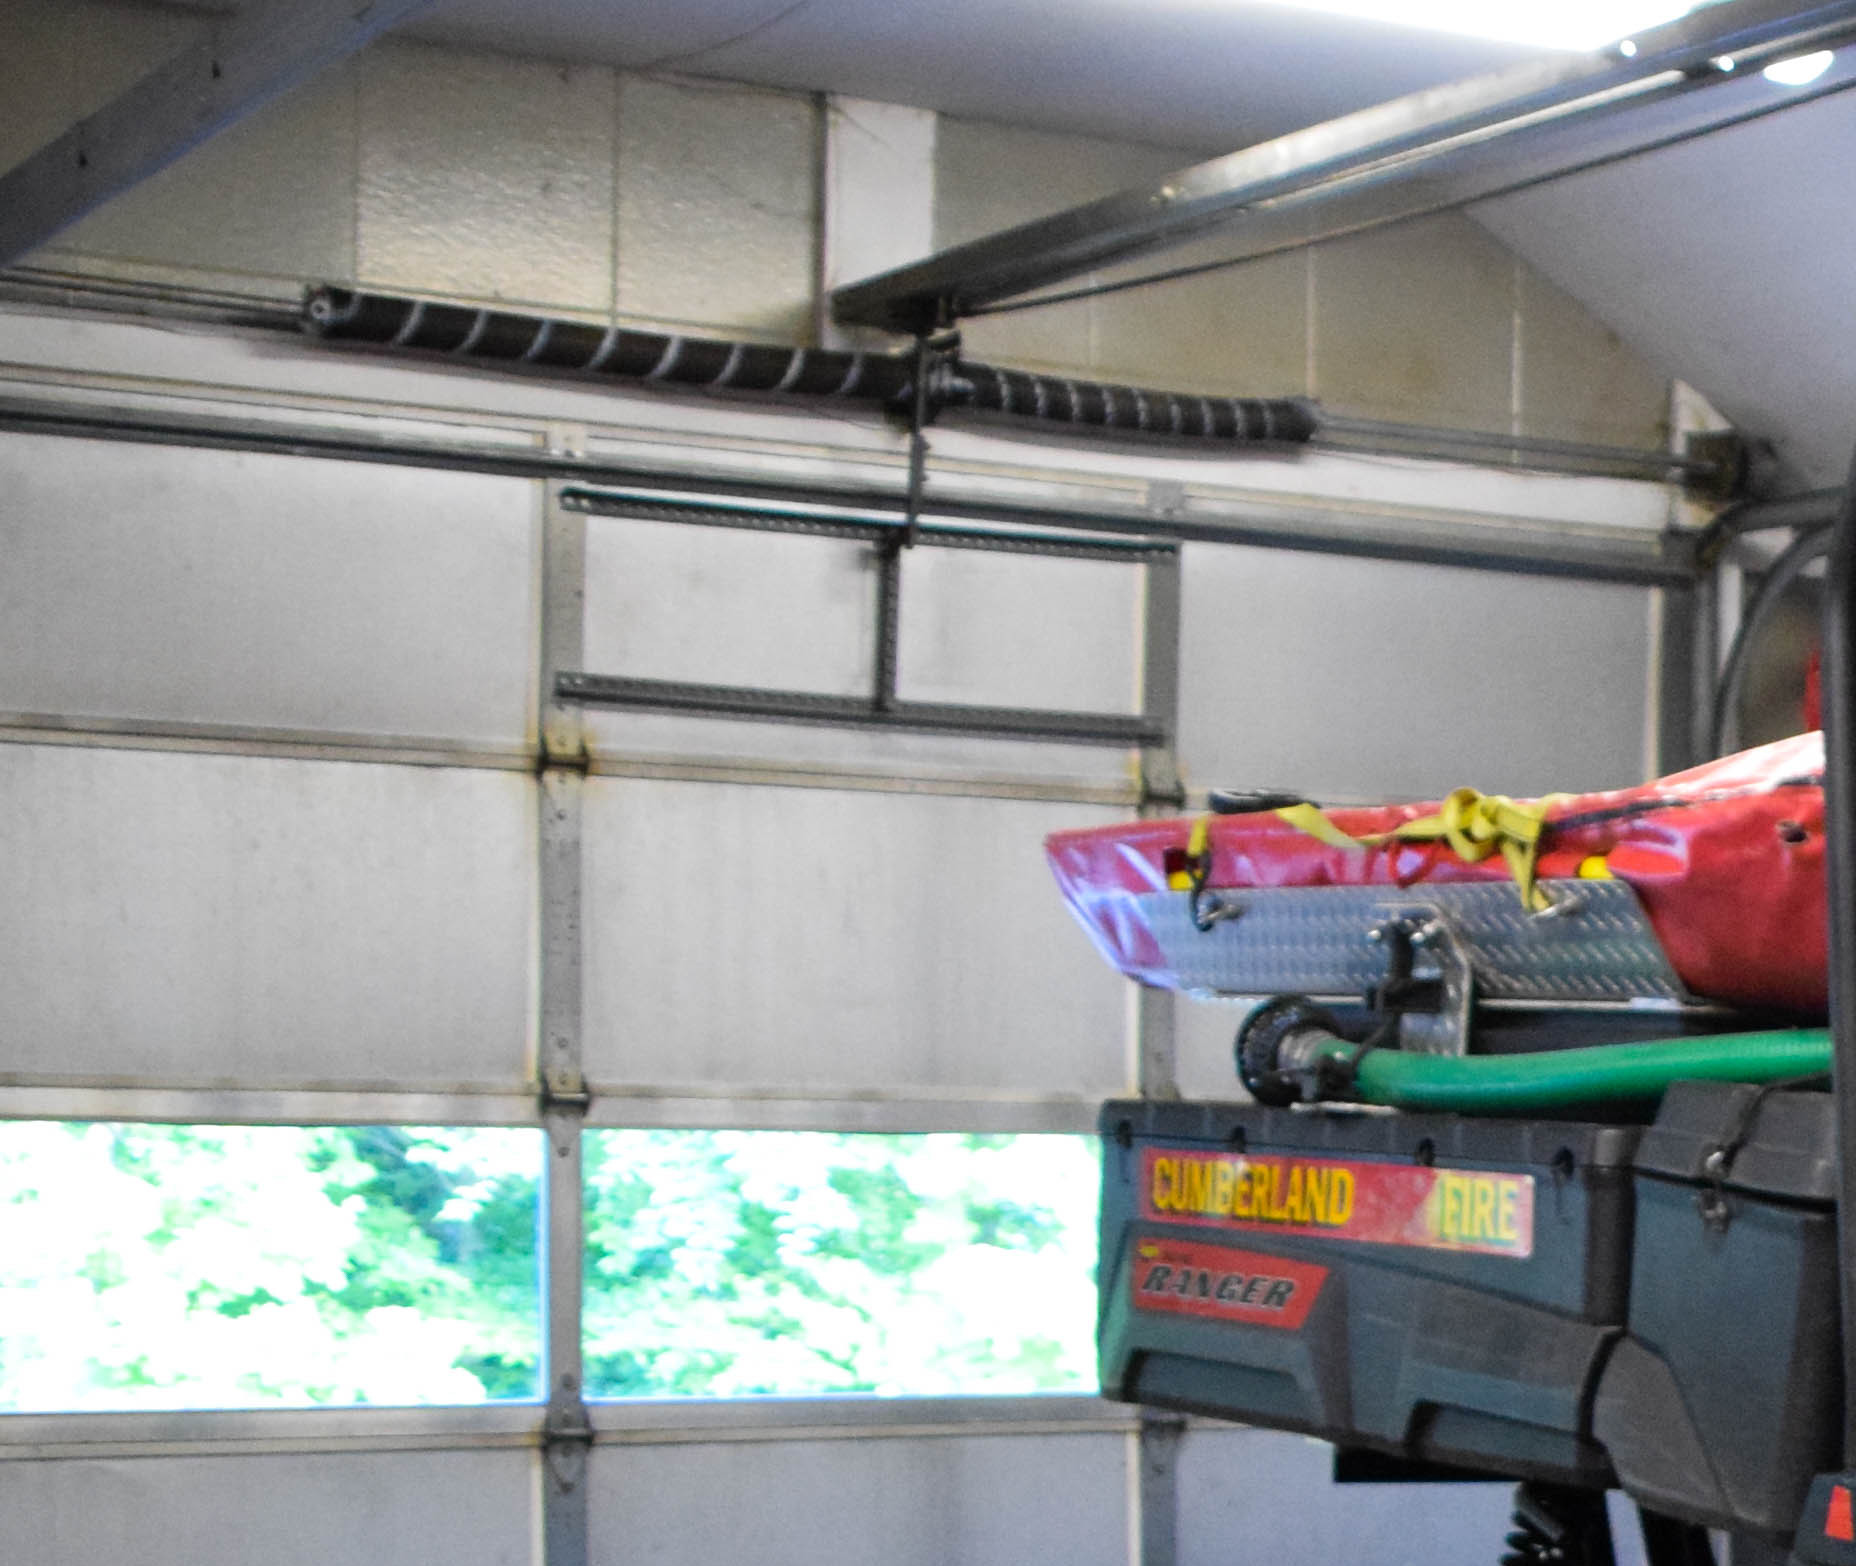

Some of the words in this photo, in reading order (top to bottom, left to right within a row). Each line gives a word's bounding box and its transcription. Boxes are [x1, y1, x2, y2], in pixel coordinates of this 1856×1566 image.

[1152, 1157, 1356, 1228] CUMBERLAND
[1440, 1174, 1520, 1243] FIRE
[1140, 1263, 1298, 1312] RANGER
